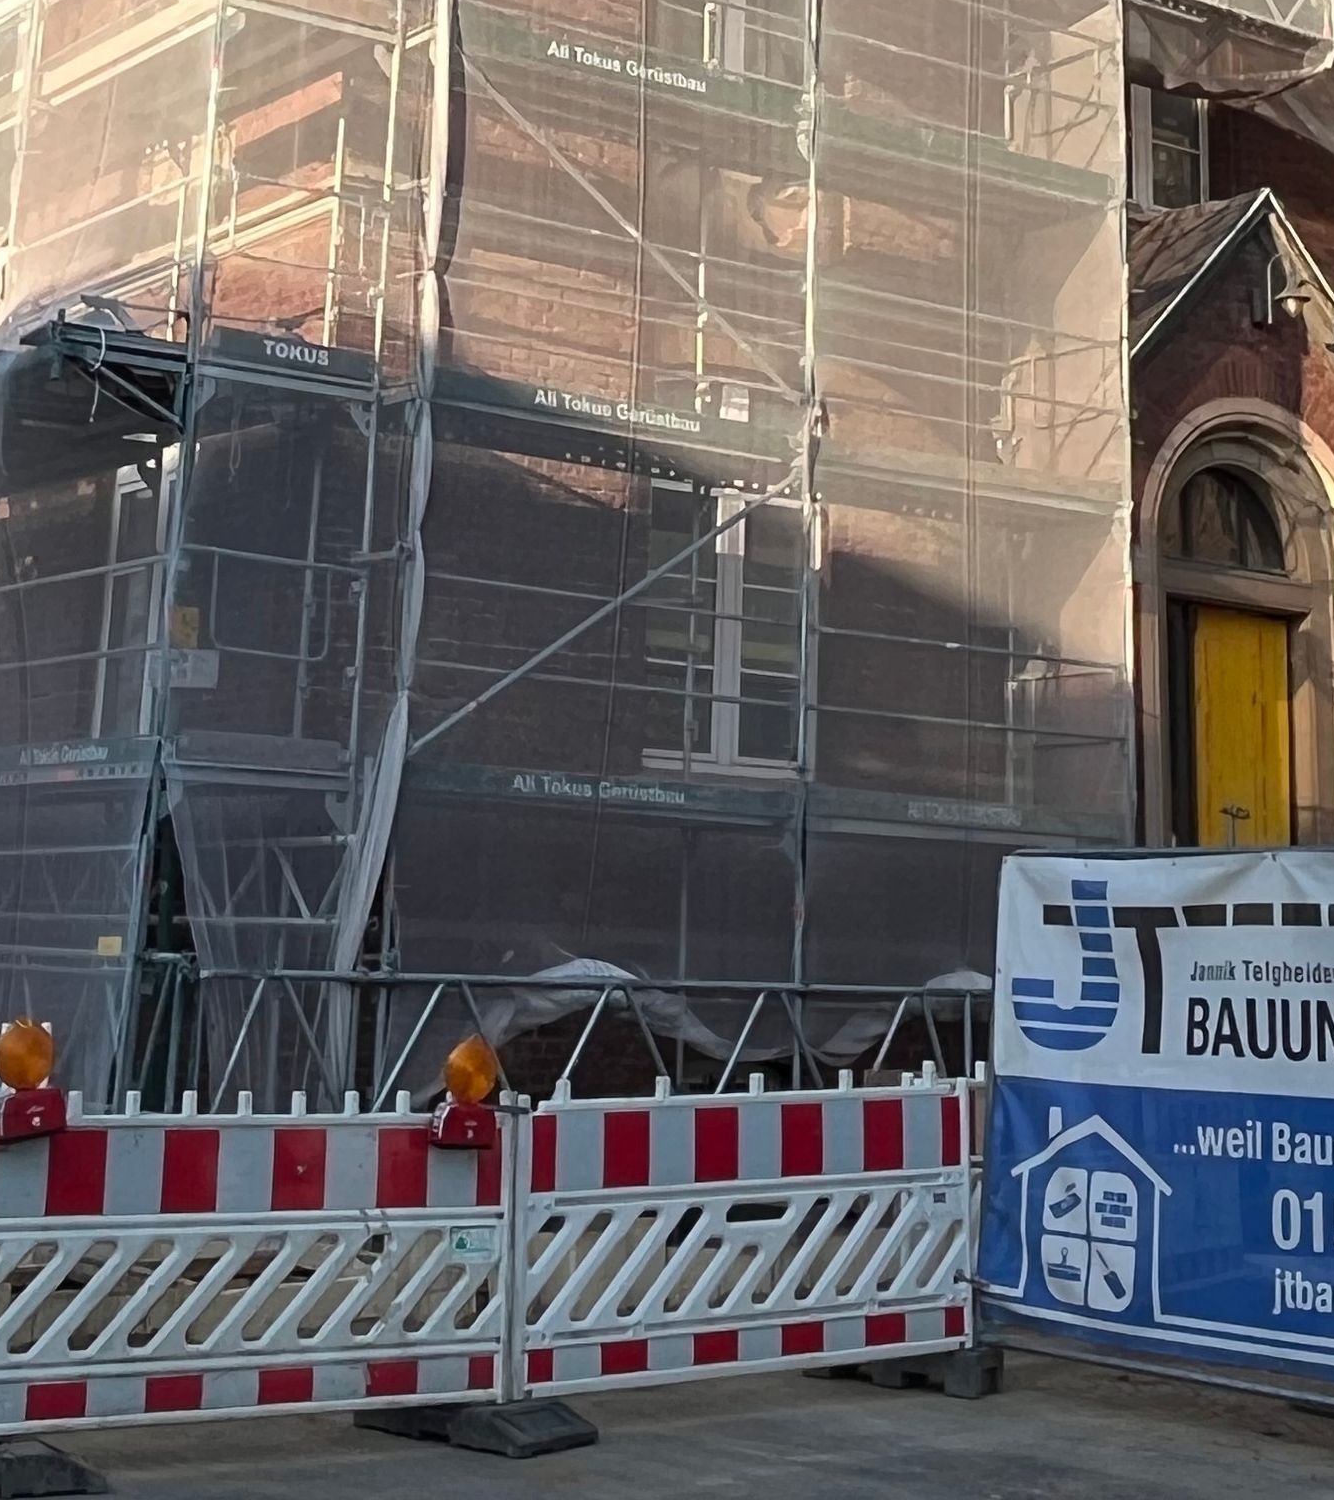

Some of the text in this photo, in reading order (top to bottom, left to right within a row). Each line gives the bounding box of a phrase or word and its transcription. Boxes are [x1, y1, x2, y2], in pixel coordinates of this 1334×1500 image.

[574, 46, 621, 73] Tokus
[626, 60, 706, 93] Gerüstbau
[263, 339, 329, 366] TOKUS
[562, 393, 612, 417] Tokus
[541, 776, 592, 798] Tokus
[1190, 960, 1236, 982] Jannik
